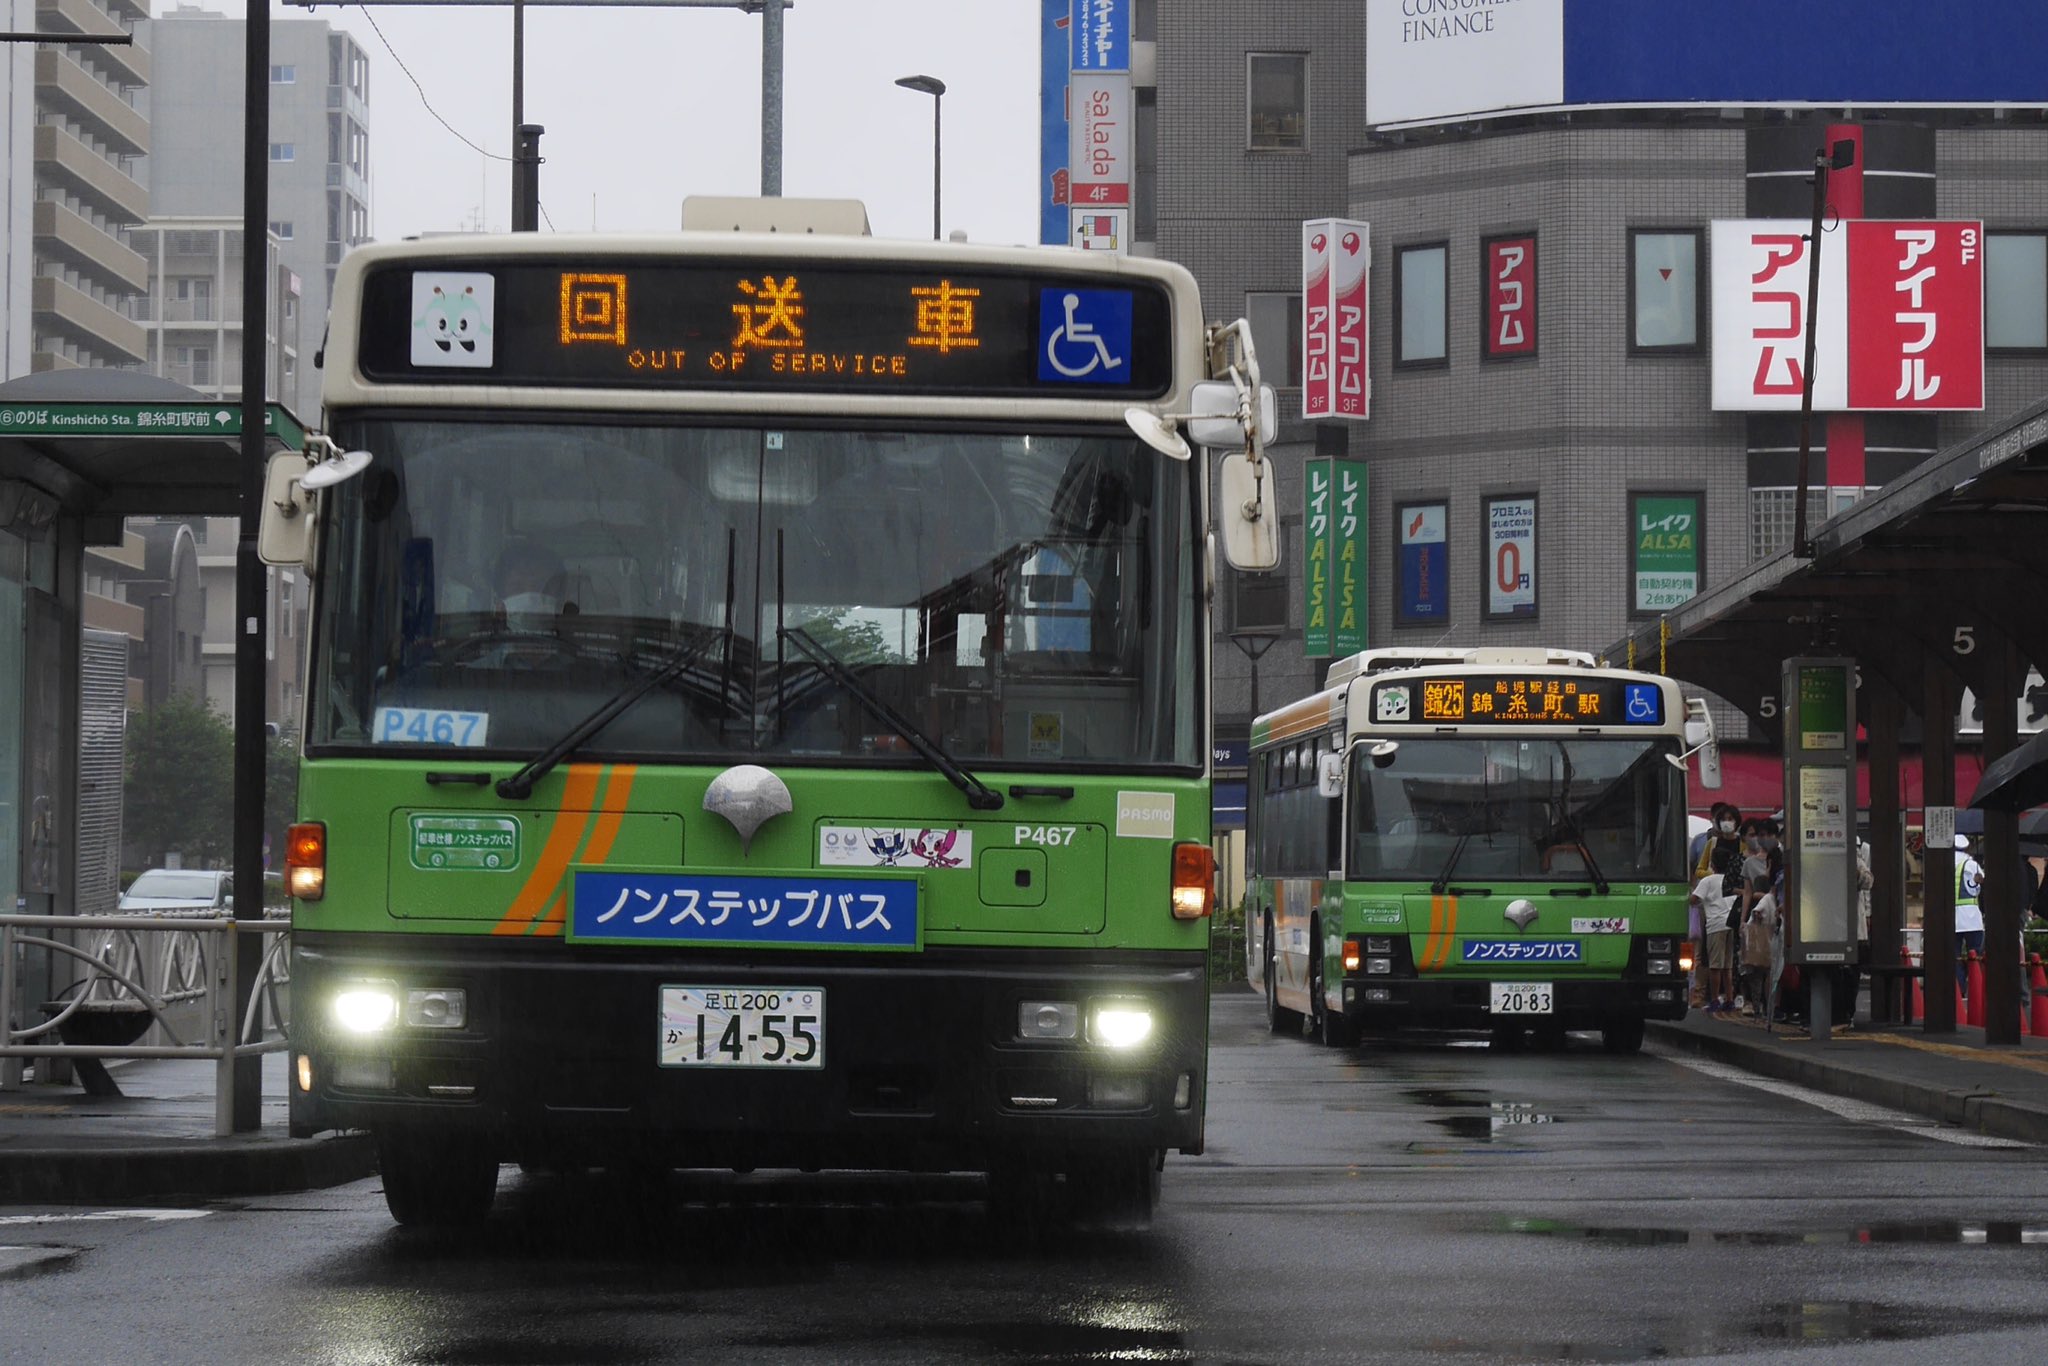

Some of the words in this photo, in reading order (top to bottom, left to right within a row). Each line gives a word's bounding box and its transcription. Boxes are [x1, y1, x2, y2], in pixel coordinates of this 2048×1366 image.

[1403, 0, 1520, 16] CONS
[1403, 10, 1494, 42] FINANCE
[1093, 91, 1116, 176] salada
[1090, 188, 1109, 200] 4F
[1960, 228, 1977, 265] 3F
[1500, 246, 1524, 345] アコム
[1750, 234, 1804, 395] アコム
[1895, 229, 1941, 401] アイフル
[1309, 305, 1328, 381] アコム
[1340, 305, 1361, 394] アコム
[628, 350, 686, 370] OUT
[709, 351, 745, 371] OF
[771, 352, 907, 375] SERVICE
[1311, 396, 1325, 408] 3F
[1343, 398, 1358, 411] 3F
[112, 415, 133, 425] Sta.
[137, 411, 210, 427] 錦糸町駅前
[1310, 471, 1328, 537] レイク
[1340, 470, 1357, 538] レイク
[1641, 514, 1691, 531] レイク
[1640, 534, 1691, 549] ALSA
[1497, 542, 1529, 593] 0円
[1310, 538, 1326, 628] ALSA
[1340, 539, 1356, 630] ALSA
[1639, 579, 1693, 590] 自動契約機
[1953, 626, 1975, 654] 5
[1471, 692, 1600, 714] 錦糸町駅
[1760, 697, 1777, 718] 5
[383, 710, 480, 746] P467
[1213, 750, 1231, 761] ays
[1121, 808, 1171, 822] PASMO
[1015, 827, 1077, 846] P467
[1639, 885, 1667, 896] T228
[597, 887, 892, 930] ノンステップバス
[1466, 942, 1579, 959] ノンステップバス
[705, 993, 780, 1010] 足立200
[1501, 993, 1551, 1012] 20-83
[667, 1030, 683, 1044] か
[696, 1014, 817, 1062] 14-55
